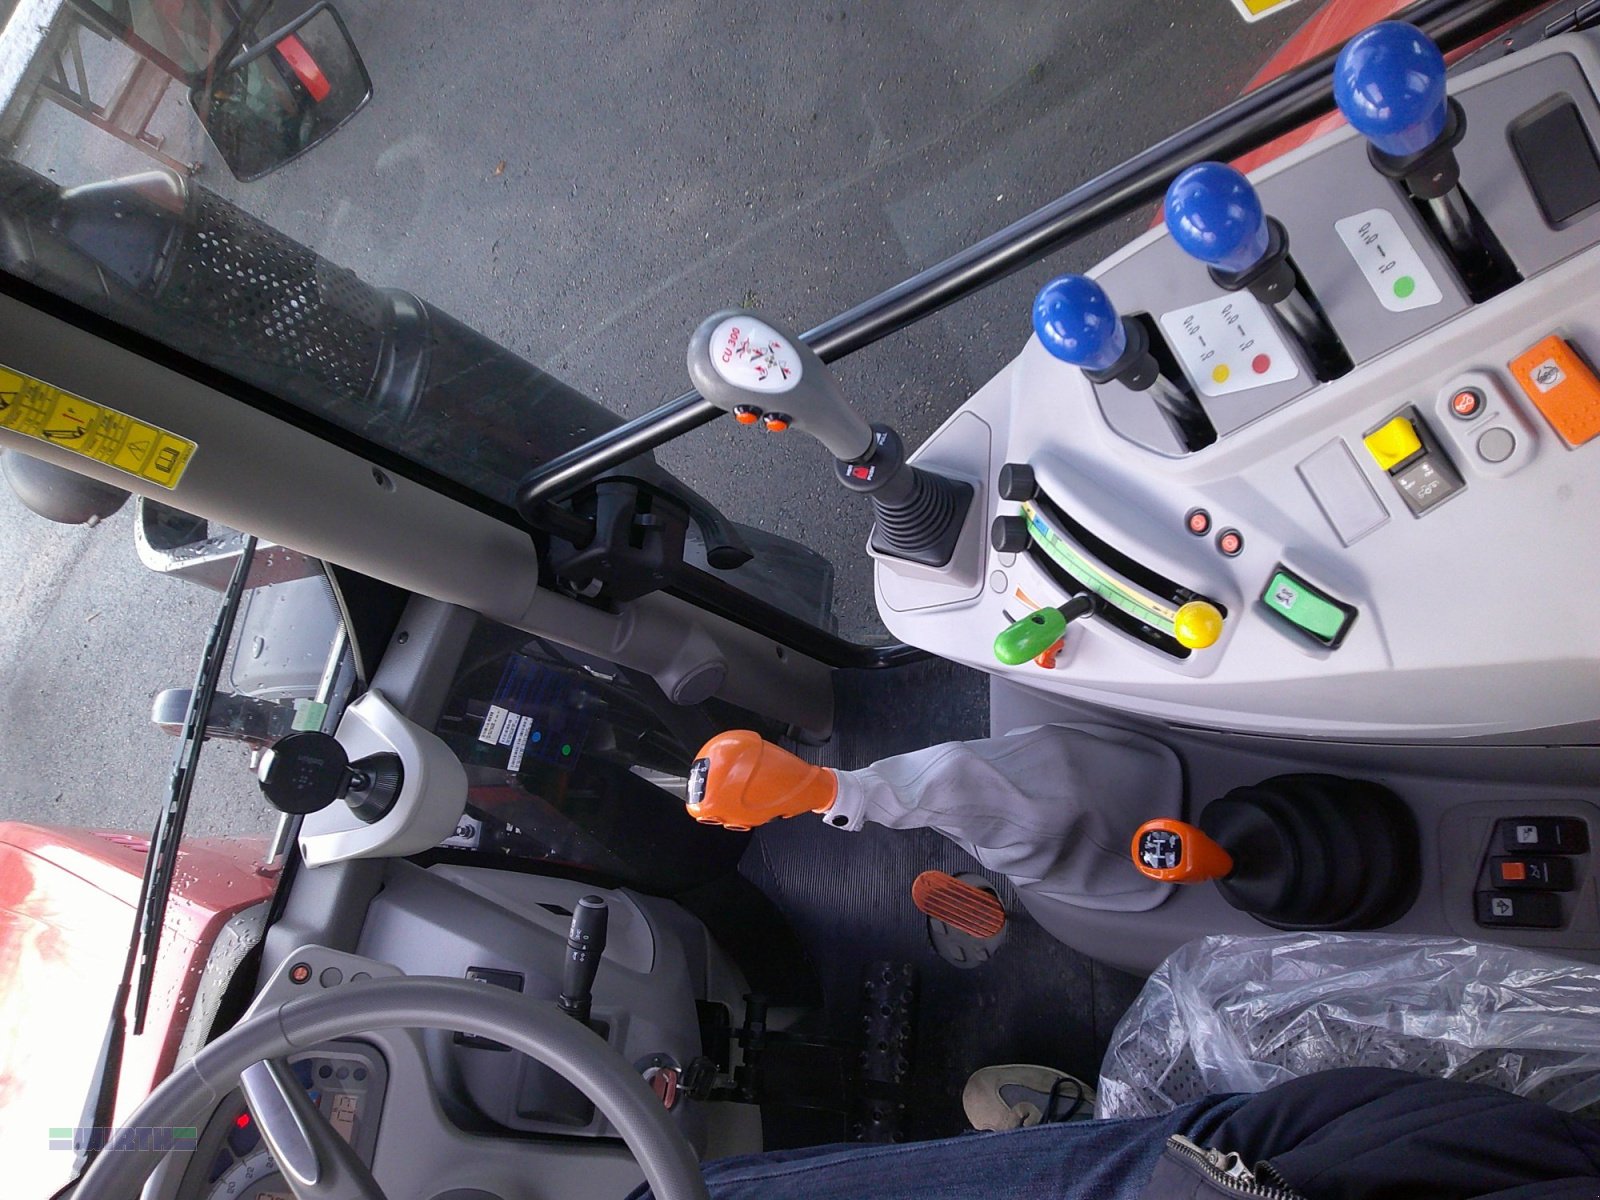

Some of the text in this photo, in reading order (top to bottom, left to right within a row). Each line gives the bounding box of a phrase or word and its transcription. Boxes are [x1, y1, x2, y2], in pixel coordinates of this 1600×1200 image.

[721, 327, 740, 363] CU 300
[265, 1156, 274, 1168] 24
[245, 1167, 255, 1179] 22
[226, 1181, 236, 1194] 20
